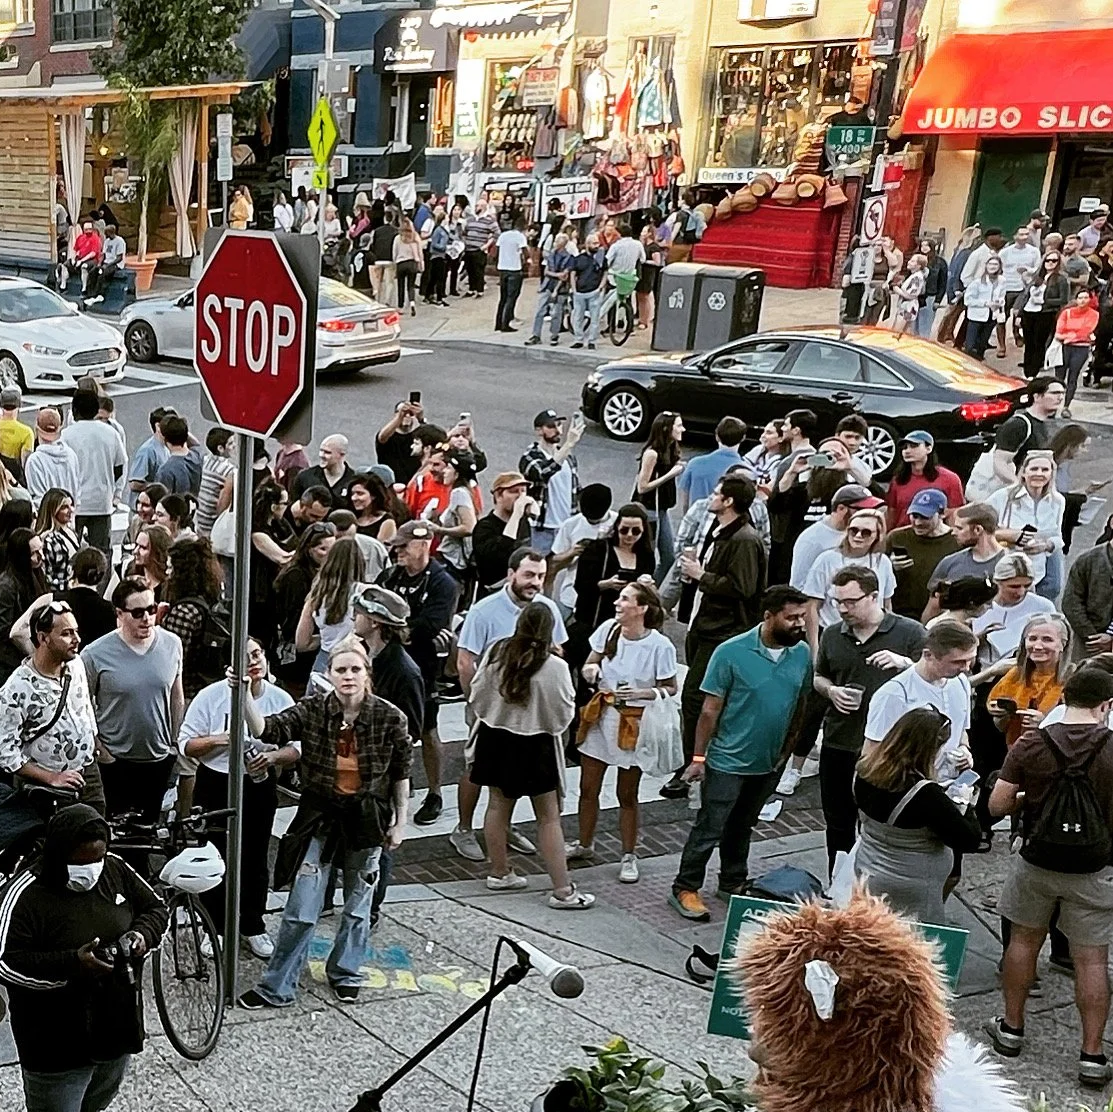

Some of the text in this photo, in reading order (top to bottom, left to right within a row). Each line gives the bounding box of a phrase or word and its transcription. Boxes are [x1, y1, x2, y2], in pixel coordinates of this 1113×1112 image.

[917, 105, 1113, 129] JUMBO SLIC
[840, 129, 854, 143] 18
[836, 144, 861, 154] 2400
[702, 170, 744, 181] Queen's
[200, 293, 297, 376] STOP
